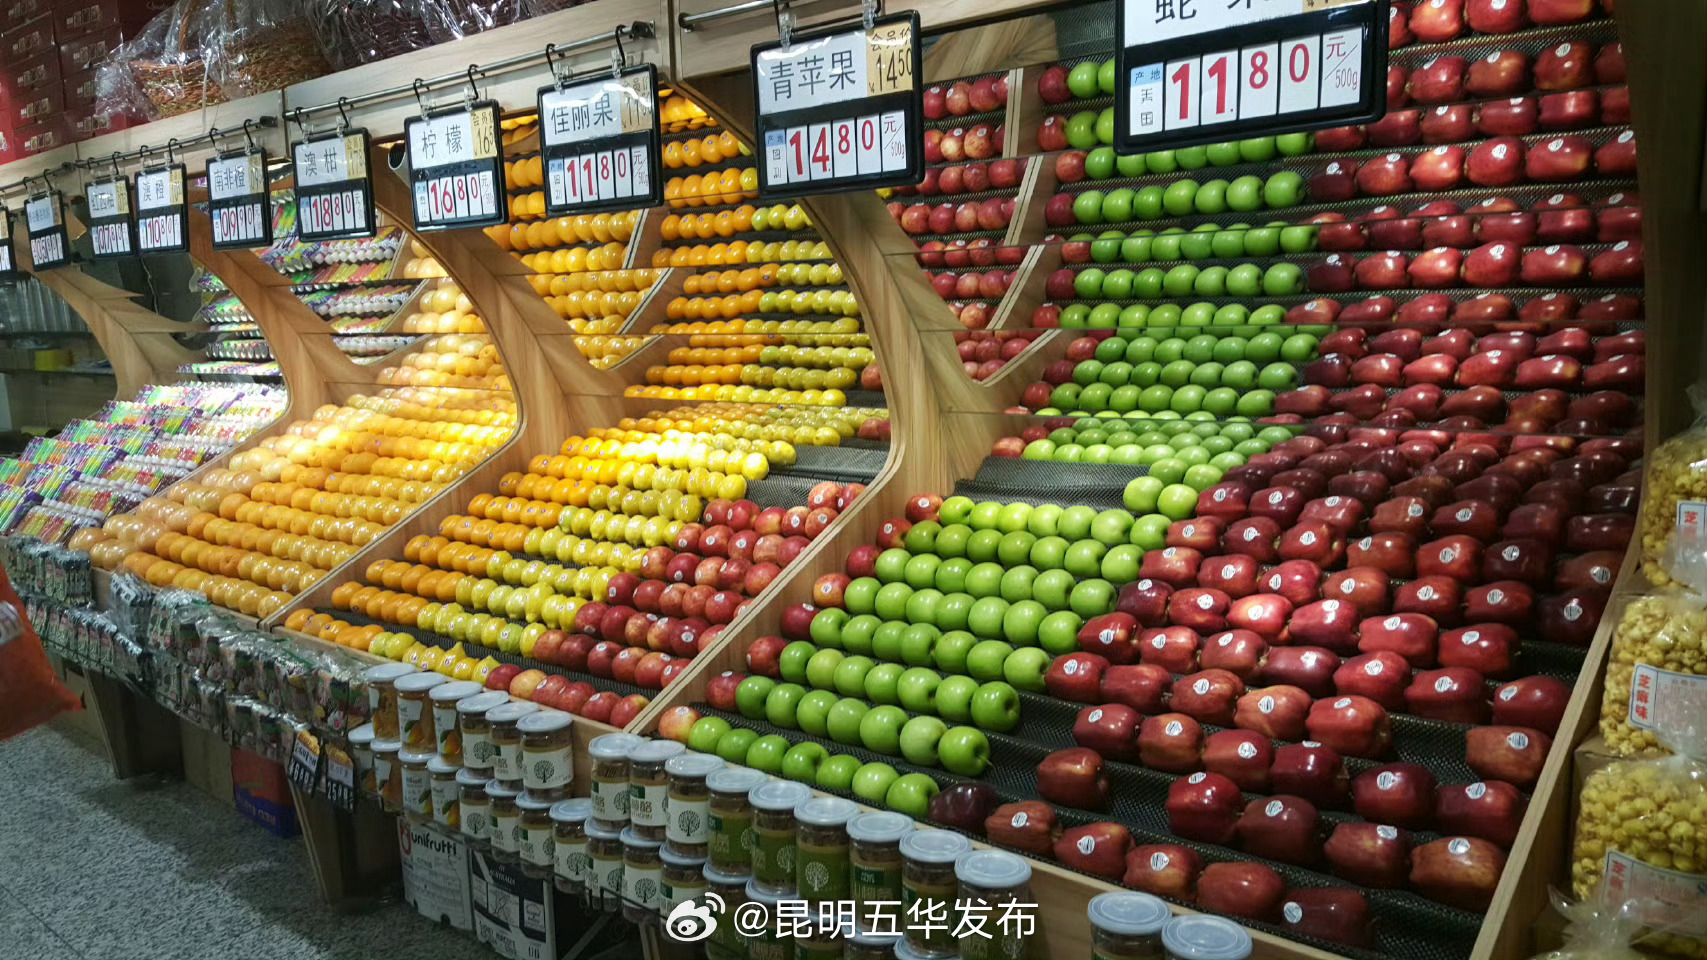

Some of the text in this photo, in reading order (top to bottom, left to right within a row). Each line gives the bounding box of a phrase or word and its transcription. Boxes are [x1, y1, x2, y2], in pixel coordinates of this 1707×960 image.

[768, 50, 857, 101] 青苹果
[1134, 67, 1161, 84] 产地
[551, 92, 613, 136] 佳丽果
[422, 124, 463, 160] 柠檬
[214, 165, 245, 192] 南非橙
[304, 147, 337, 177] 澳柑
[1635, 674, 1651, 720] 芝麻味
[411, 832, 457, 856] unifrutti
